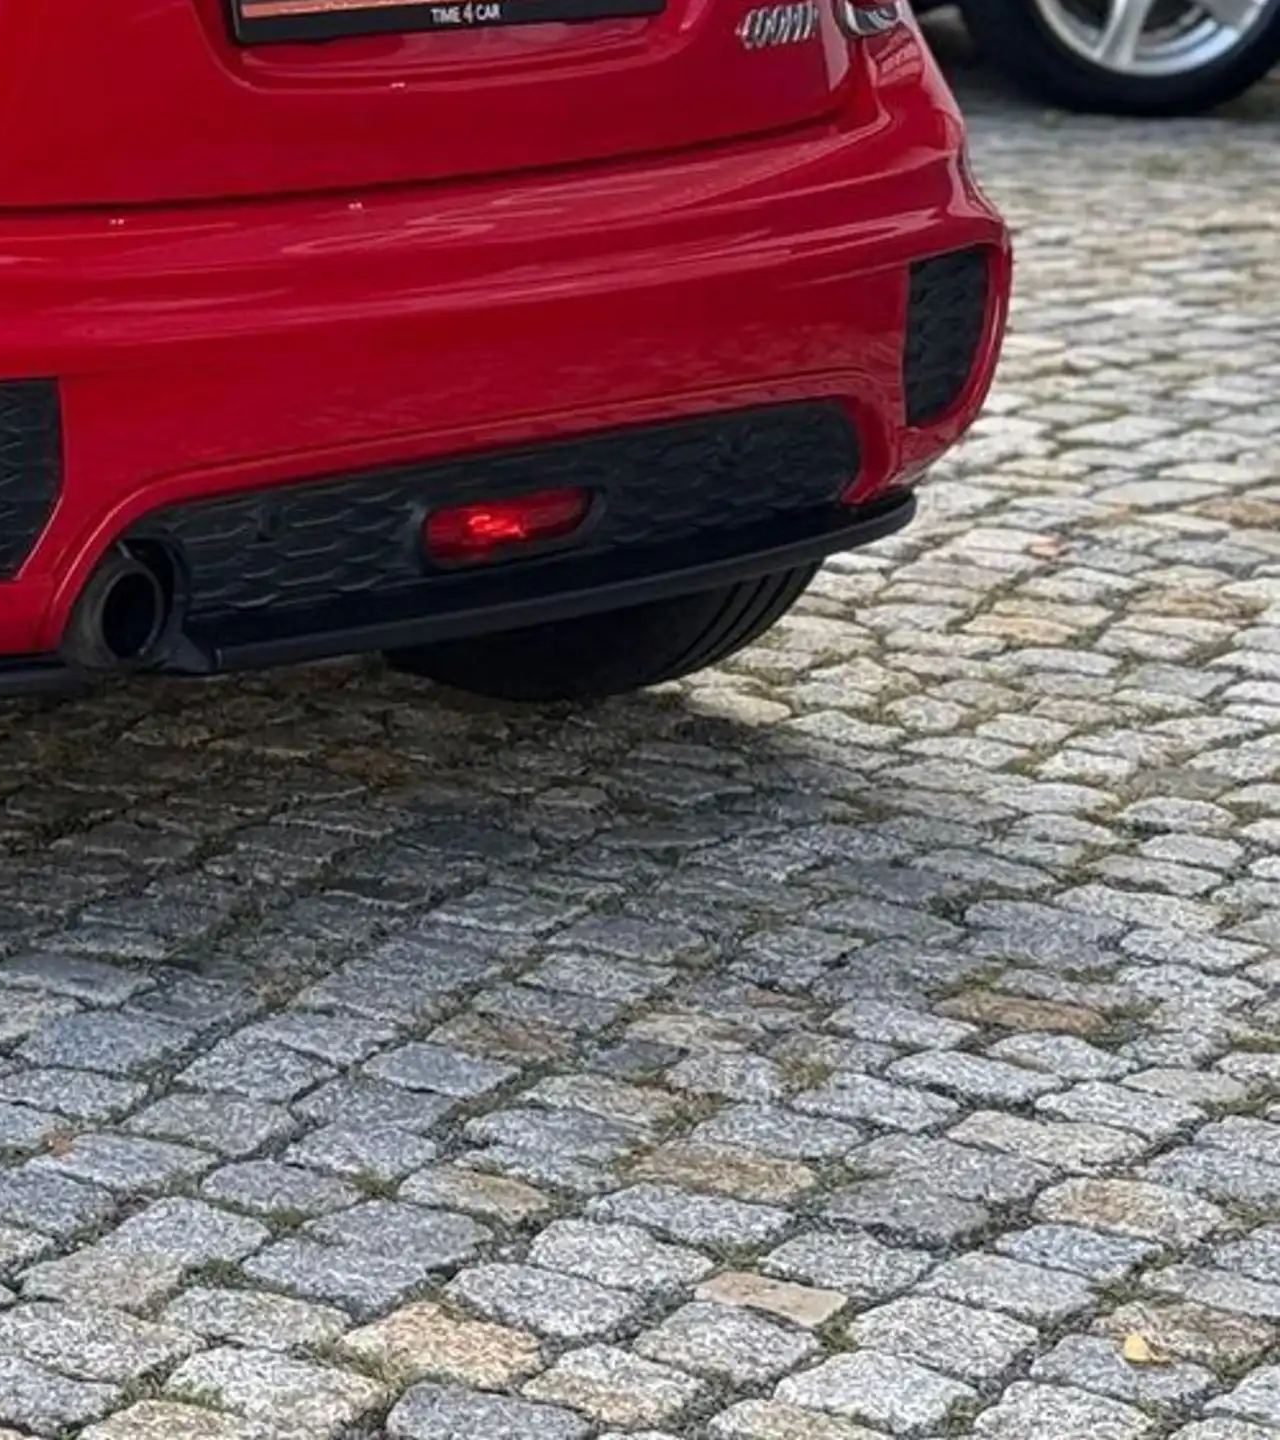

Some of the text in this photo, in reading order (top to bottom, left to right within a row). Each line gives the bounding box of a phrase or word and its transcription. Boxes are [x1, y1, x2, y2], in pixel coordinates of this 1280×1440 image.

[430, 6, 461, 24] TIME
[463, 1, 473, 24] 4
[476, 3, 500, 21] CAR
